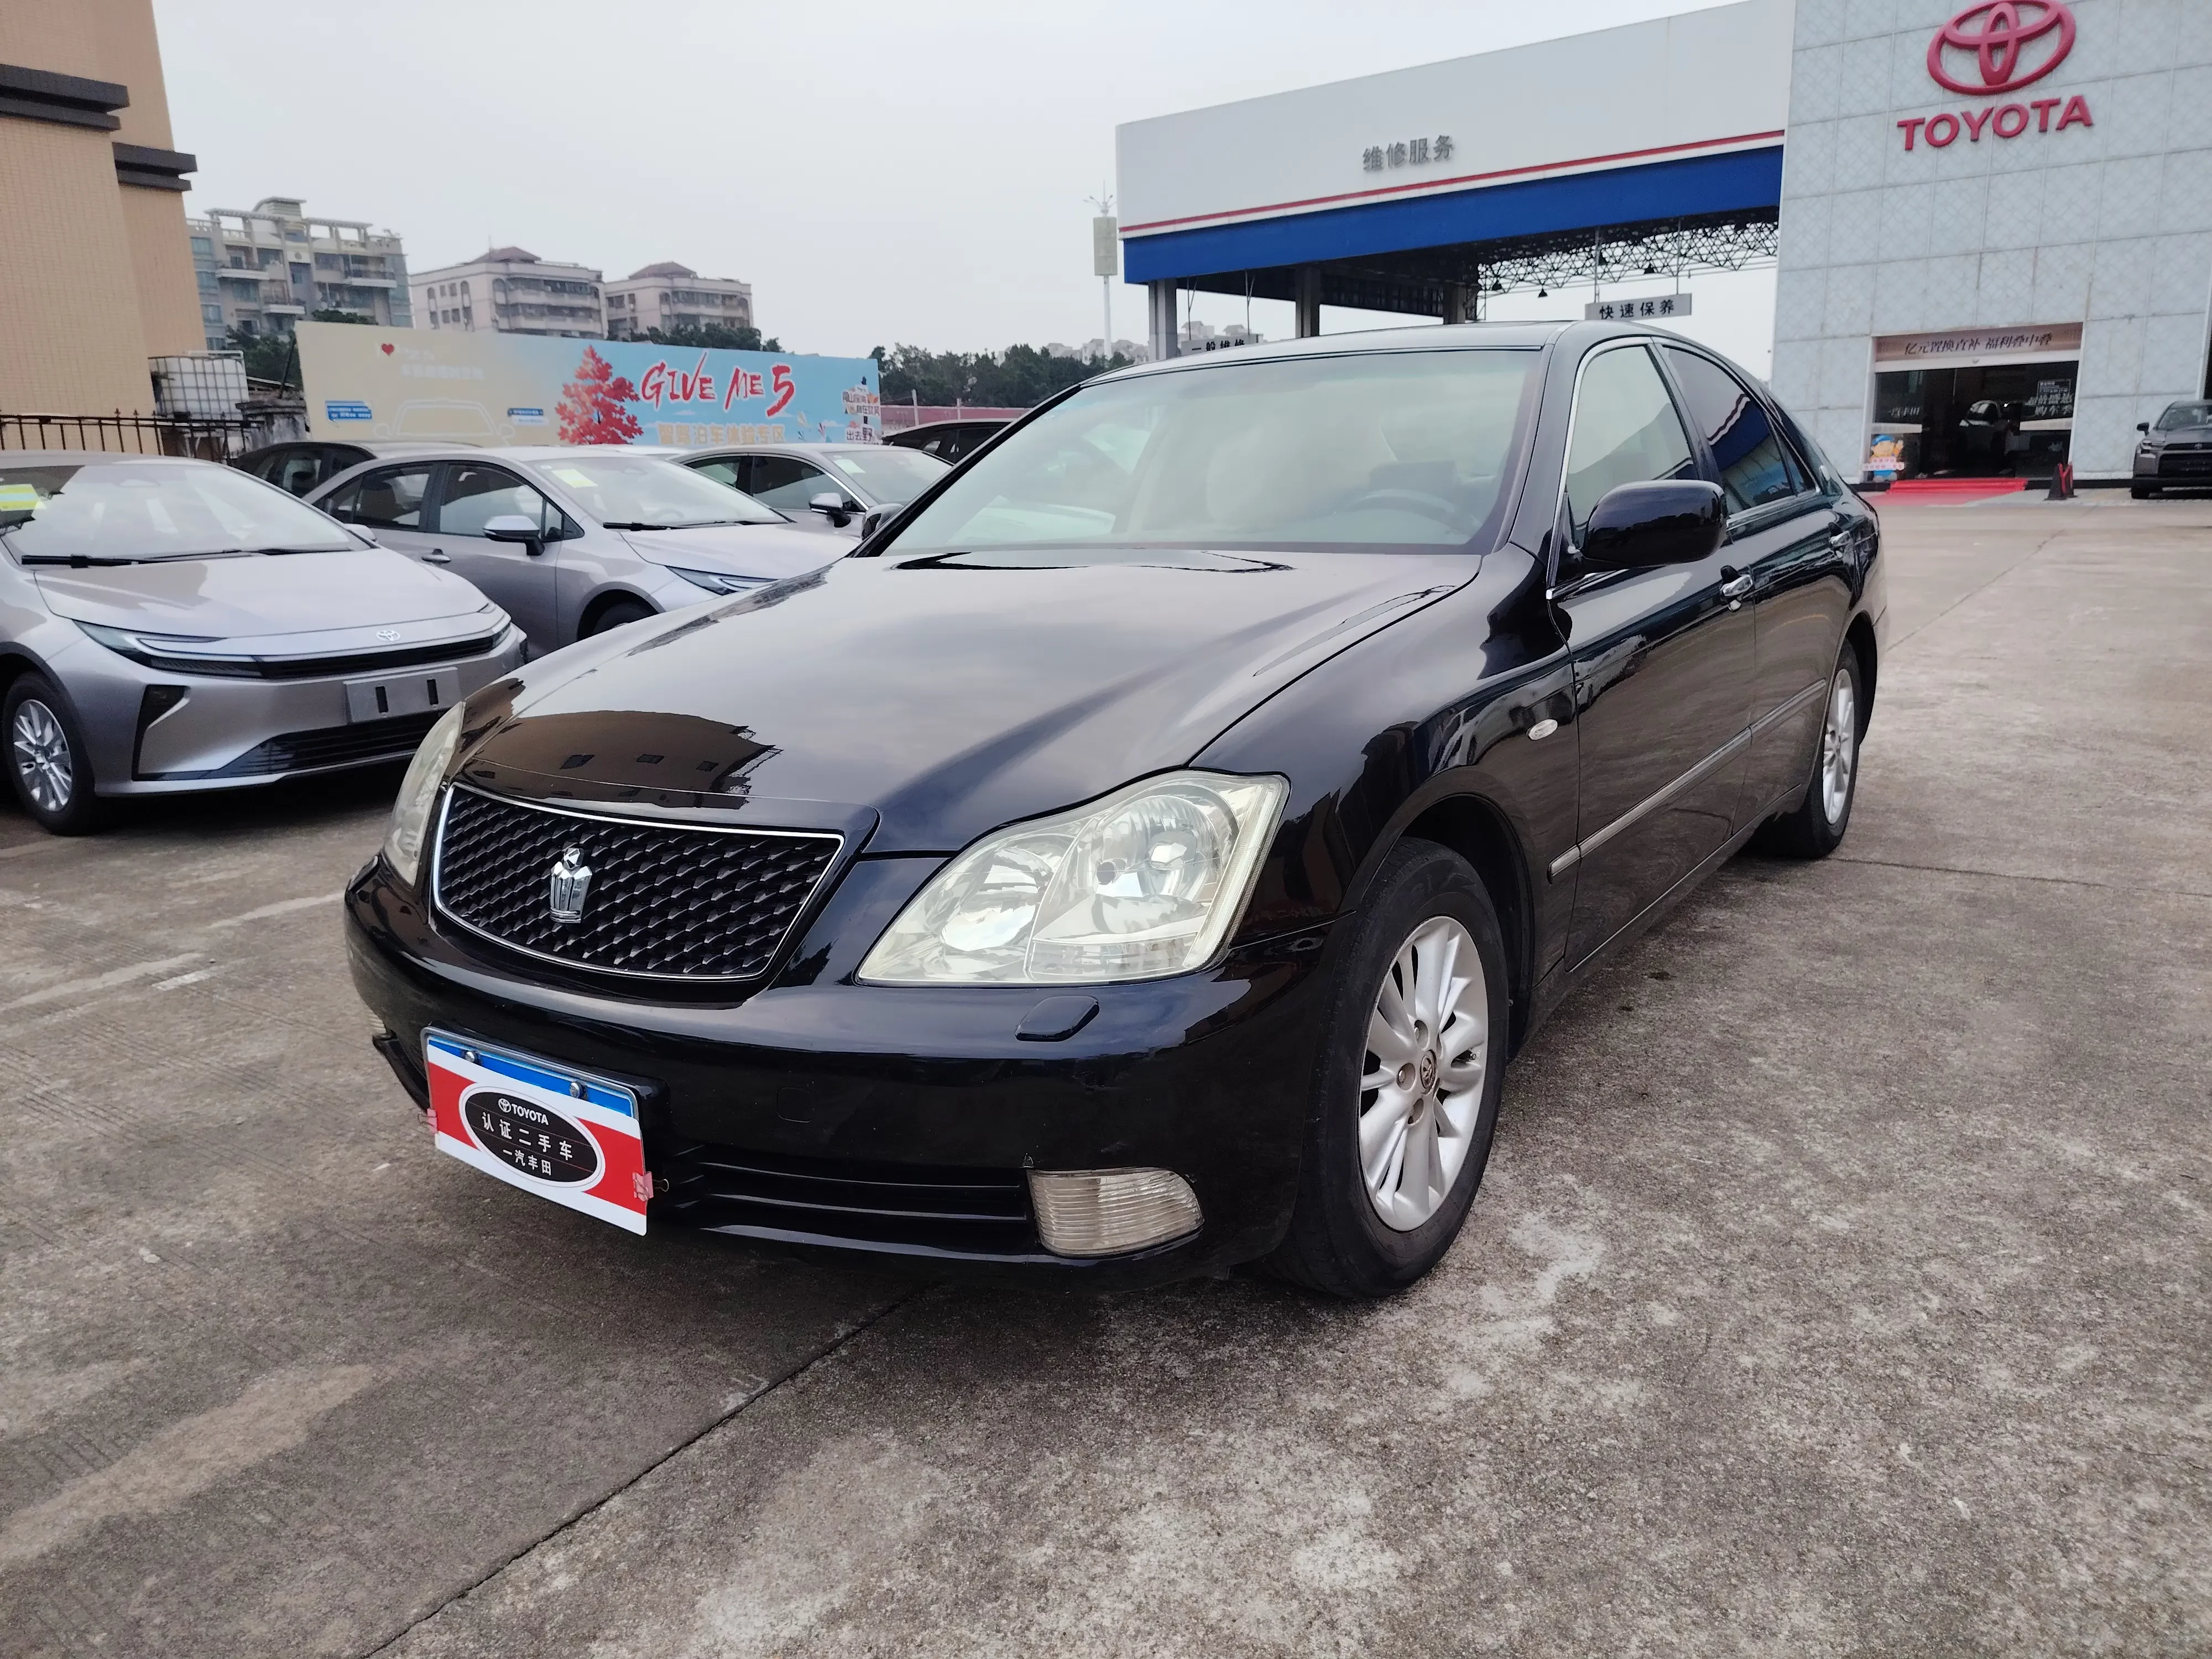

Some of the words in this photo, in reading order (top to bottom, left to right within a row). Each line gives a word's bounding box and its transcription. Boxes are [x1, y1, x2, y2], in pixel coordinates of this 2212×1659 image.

[1897, 95, 2094, 152] TOYOTA
[1363, 134, 1455, 171] 维修服务
[1599, 299, 1674, 320] 快速保养
[641, 352, 716, 410] GIVE
[724, 366, 764, 410] ME
[766, 365, 795, 418] 5
[658, 422, 785, 445] 智驾泊车体验专区
[512, 1103, 549, 1125] TOYOTA
[482, 1112, 573, 1161] 认证二手车
[503, 1148, 552, 1176] 一汽丰田
